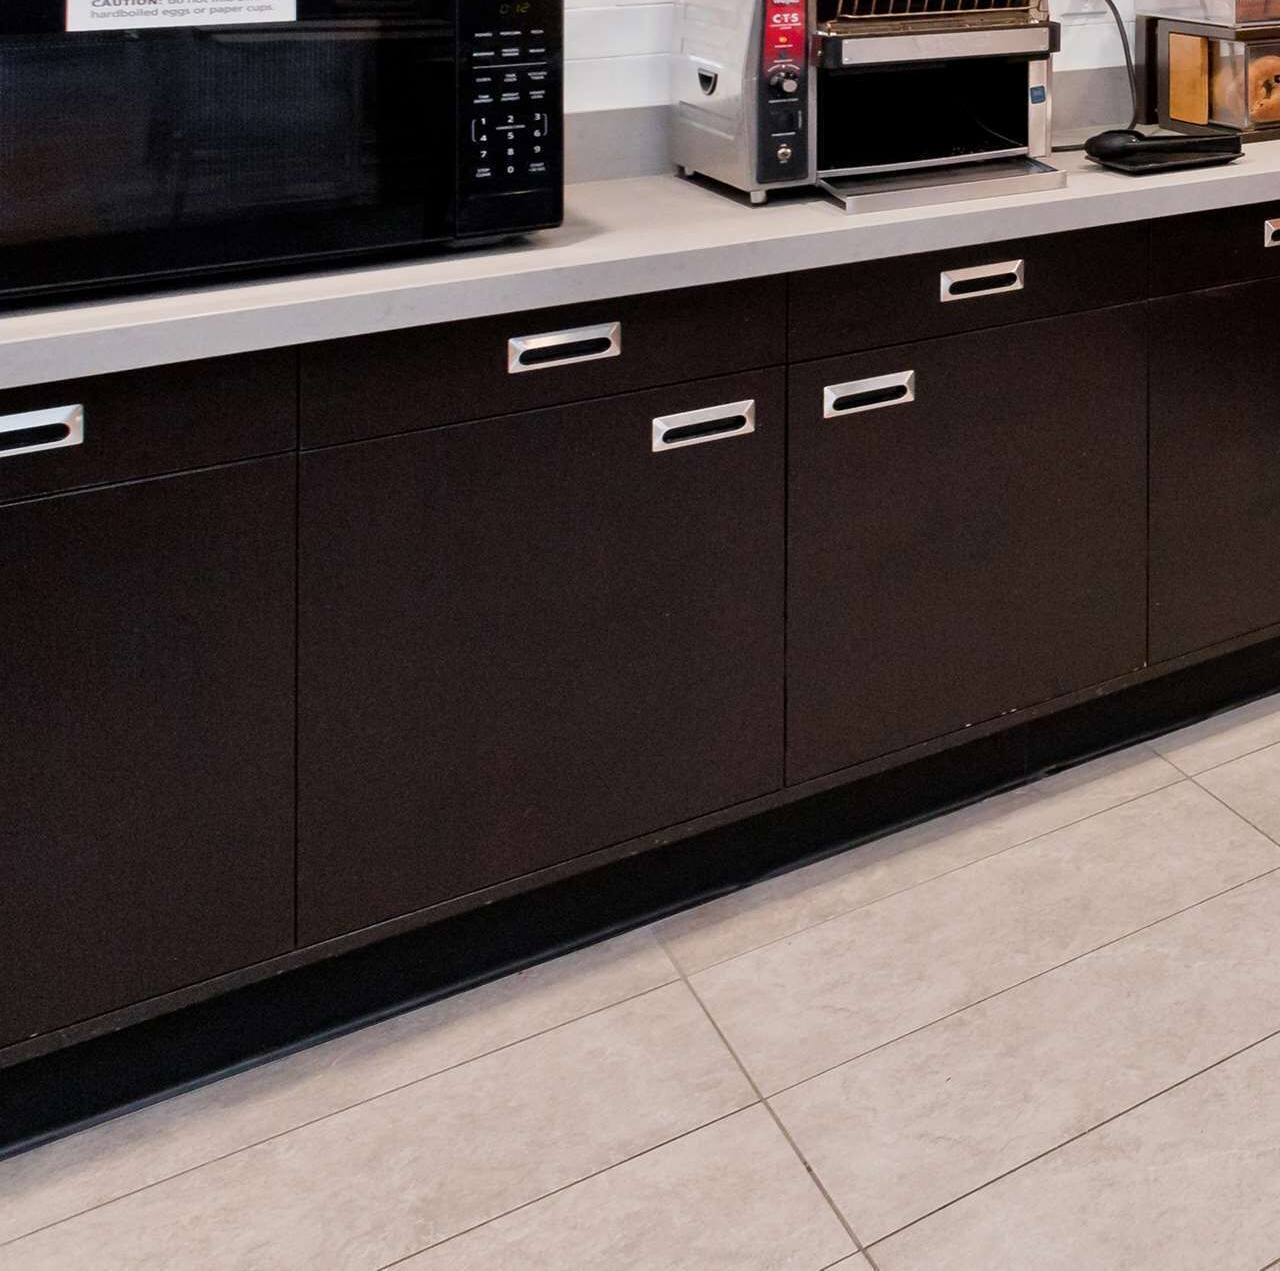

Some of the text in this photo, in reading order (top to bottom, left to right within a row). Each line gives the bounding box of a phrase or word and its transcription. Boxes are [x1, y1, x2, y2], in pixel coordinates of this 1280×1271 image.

[90, 7, 159, 19] hardboiled
[162, 8, 190, 19] eggs
[193, 6, 206, 15] or
[209, 4, 243, 16] paper
[507, 115, 514, 123] 2
[534, 129, 541, 137] 6
[480, 150, 487, 158] 7
[534, 145, 541, 153] 9
